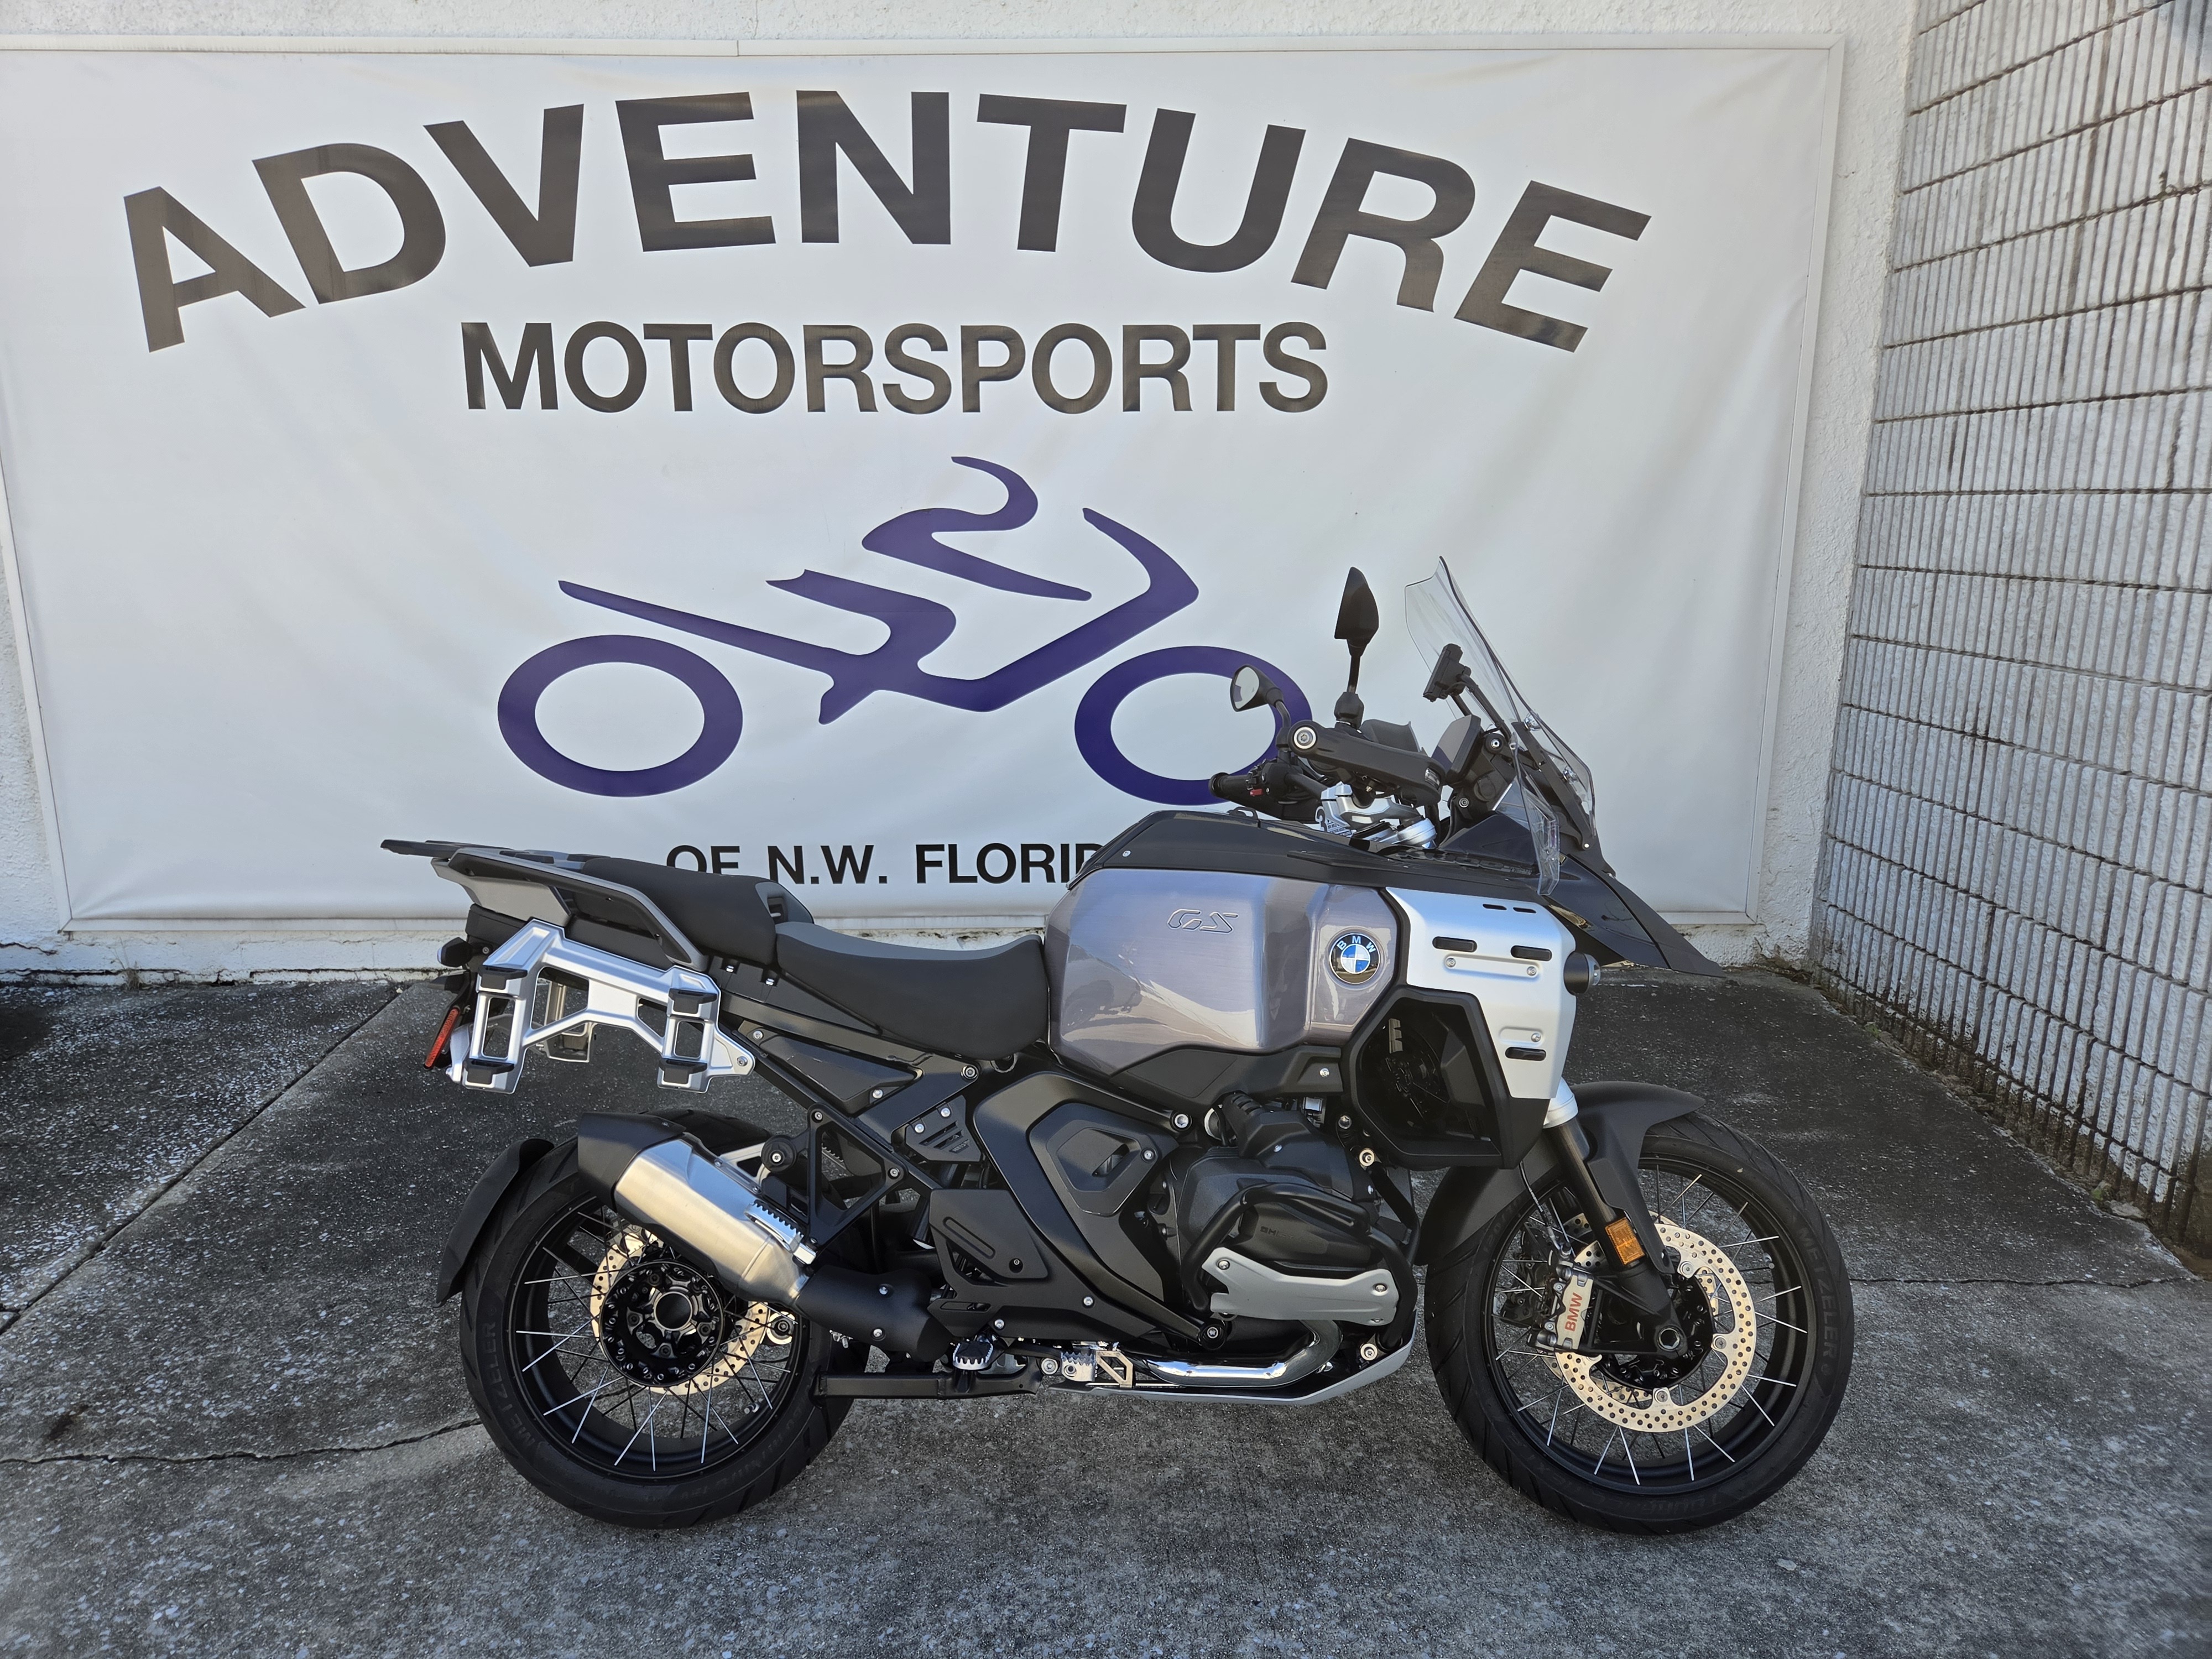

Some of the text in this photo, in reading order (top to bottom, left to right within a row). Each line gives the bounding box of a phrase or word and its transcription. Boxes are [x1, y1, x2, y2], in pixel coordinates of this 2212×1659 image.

[124, 90, 1651, 352] ADVENTURE
[461, 321, 1329, 414] MOTORSPORTS
[666, 844, 740, 875] OF
[768, 844, 888, 885] N.W.
[1336, 935, 1376, 954] BMW
[1564, 1292, 1583, 1332] BMW
[1796, 1225, 1840, 1359] METZELER
[486, 1321, 535, 1448] METZELER
